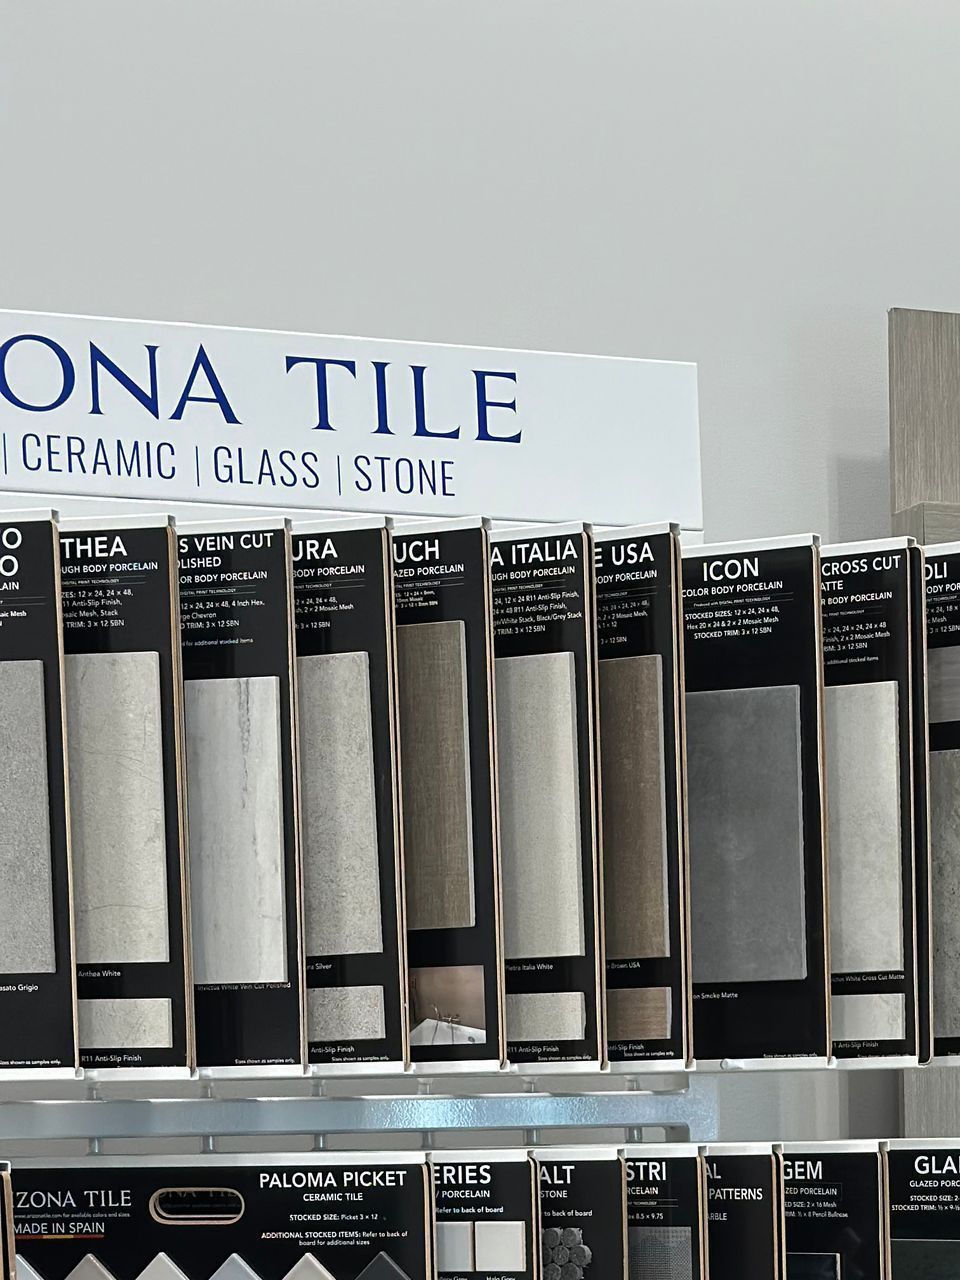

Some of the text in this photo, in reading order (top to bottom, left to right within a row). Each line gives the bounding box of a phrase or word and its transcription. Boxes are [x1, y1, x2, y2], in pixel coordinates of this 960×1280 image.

[286, 355, 523, 445] TILE
[21, 433, 456, 497] CERAMIC GLASS STONE
[60, 536, 128, 559] THEA
[194, 536, 234, 552] VEIN
[240, 532, 274, 549] CUT
[292, 538, 338, 561] URA
[393, 539, 440, 563] UCH
[511, 539, 578, 565] ITALIA
[611, 542, 655, 566] USA
[83, 562, 158, 573] BODY PORCELAIN
[317, 565, 365, 576] PORCELAIN
[417, 564, 464, 576] PORCELAIN
[510, 566, 576, 580] BODY PORCELAIN
[703, 557, 759, 582] ICON
[821, 555, 901, 577] CROSS CUT
[195, 571, 268, 583] BODY PORCELAIN
[615, 570, 657, 583] PORCELAIN
[538, 592, 560, 601] Anti-Slip
[681, 581, 783, 598] COLOR BODY PORCELAIN
[827, 592, 893, 605] BODY PORCELAIN
[685, 610, 733, 621] STOCKED SIZES:
[687, 616, 779, 631] Hex Mosaic Mesh
[694, 631, 723, 640] STOCKED
[724, 629, 740, 638] TRIM:
[102, 969, 121, 978] White
[95, 1054, 142, 1064] Anti-Slip Finish
[434, 1165, 491, 1185] ERIES
[540, 1165, 575, 1184] ALT
[783, 1160, 823, 1180] GEM
[259, 1171, 407, 1189] PALOMA PICKET
[909, 1180, 939, 1188] GLAZED
[303, 1192, 363, 1202] CERAMIC TILE
[442, 1190, 490, 1198] PORCELAIN
[709, 1188, 763, 1200] PATTERNS
[800, 1187, 837, 1196] PORCELAIN
[12, 1190, 132, 1208] ZONA TILE
[14, 1222, 105, 1234] MADE IN SPAIN
